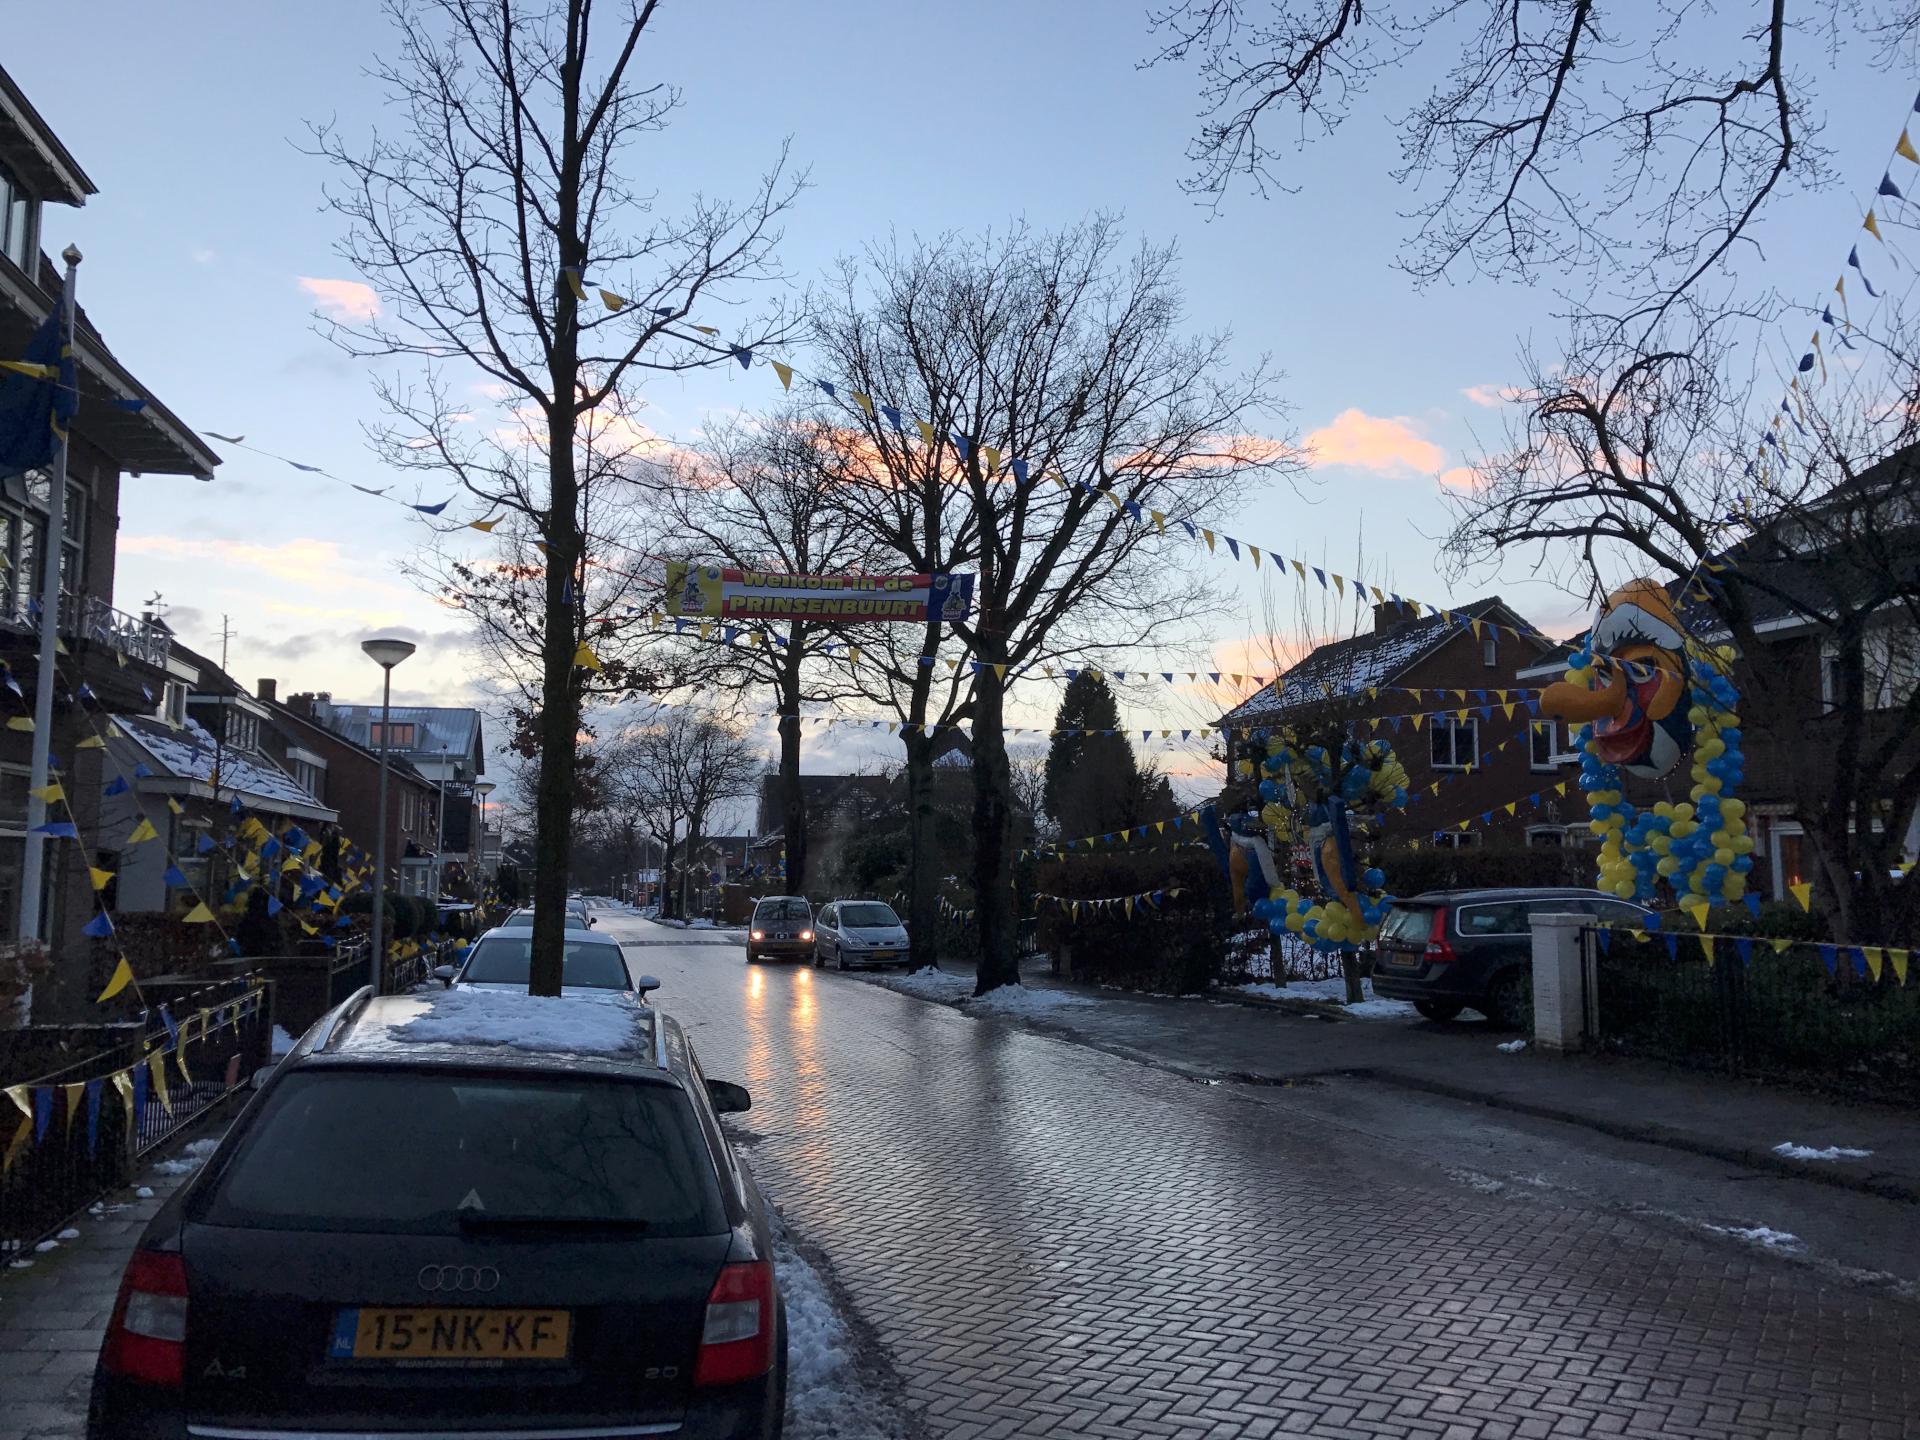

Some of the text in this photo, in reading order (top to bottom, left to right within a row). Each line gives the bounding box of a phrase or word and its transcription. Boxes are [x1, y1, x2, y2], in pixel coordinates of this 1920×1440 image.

[743, 572, 914, 592] Welkom in de
[728, 594, 921, 615] PRINSENBUURT
[336, 1337, 351, 1349] NL
[373, 1315, 554, 1351] 15-NK-KF
[203, 1357, 247, 1378] A4
